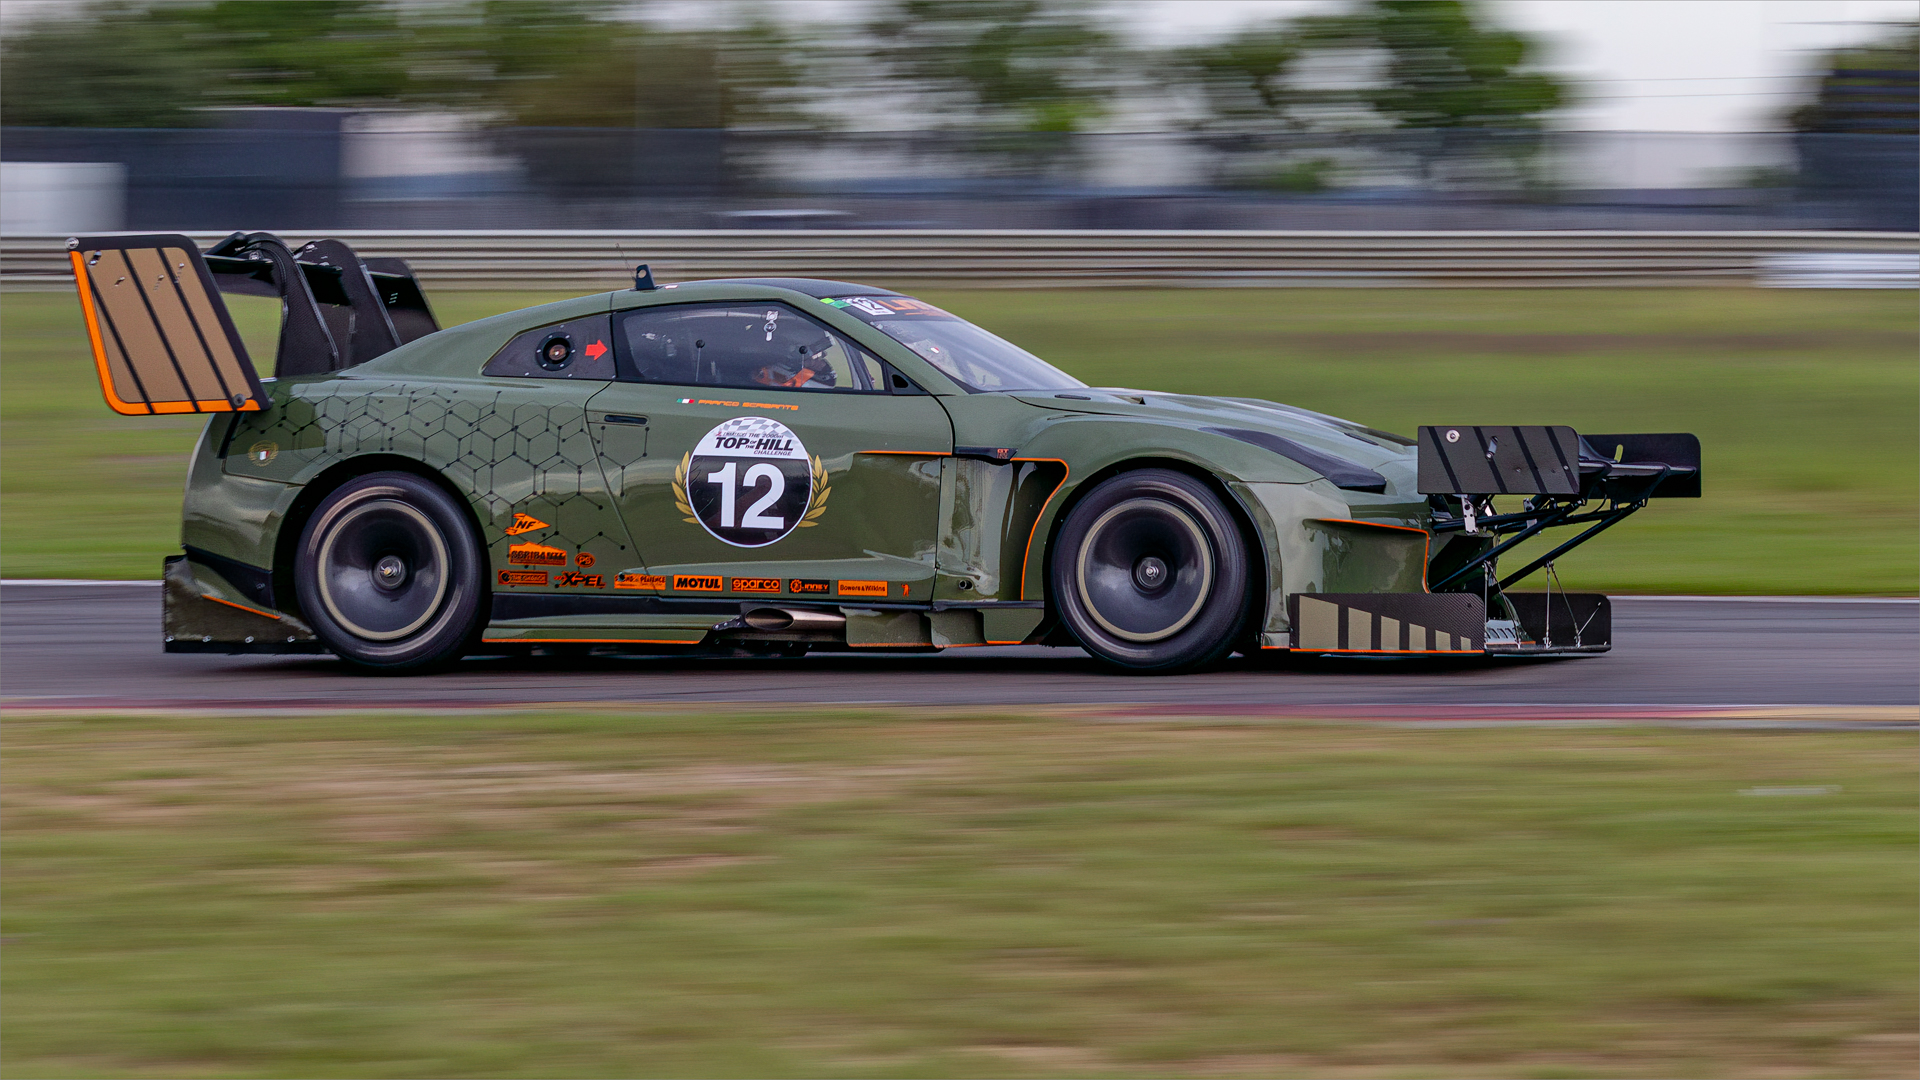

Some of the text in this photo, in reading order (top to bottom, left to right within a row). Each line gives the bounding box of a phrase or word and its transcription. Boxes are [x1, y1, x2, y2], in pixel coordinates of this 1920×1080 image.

[715, 437, 750, 449] TOP
[755, 438, 794, 451] HILL
[707, 462, 785, 529] 12
[516, 520, 536, 529] NF
[561, 573, 605, 587] XPEL
[675, 577, 721, 589] MOTUL
[732, 578, 780, 590] sparco
